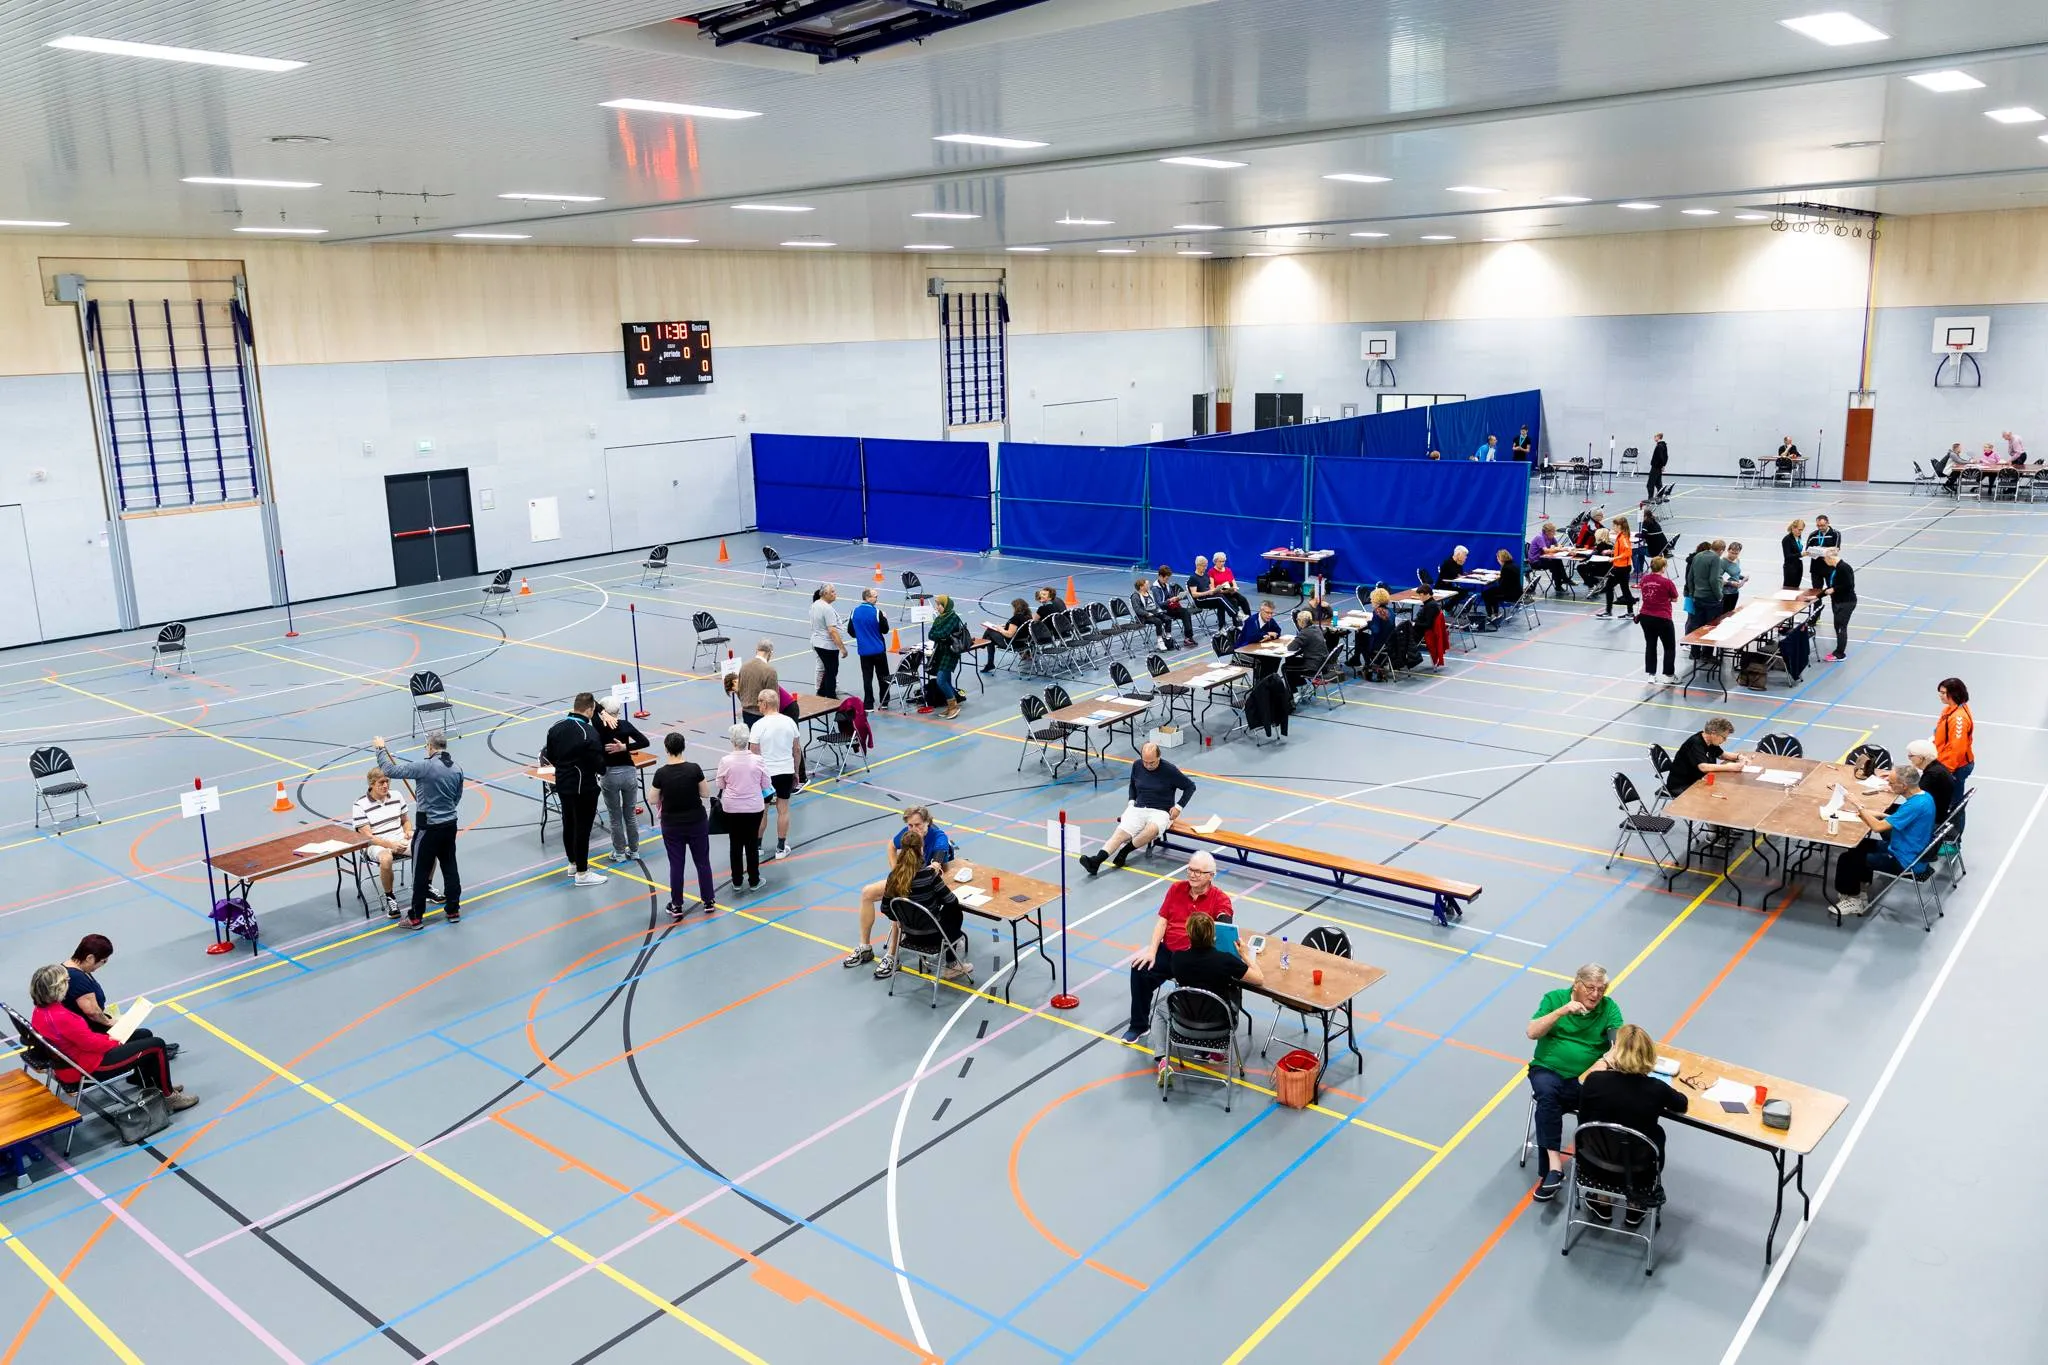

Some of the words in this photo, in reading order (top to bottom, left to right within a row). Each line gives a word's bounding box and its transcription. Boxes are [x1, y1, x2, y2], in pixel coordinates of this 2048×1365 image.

[657, 323, 688, 340] 11:38
[641, 334, 650, 352] 0
[701, 332, 710, 348] 0
[664, 350, 680, 358] periode
[684, 346, 690, 358] 0
[638, 363, 644, 376] 0
[702, 360, 708, 372] 0
